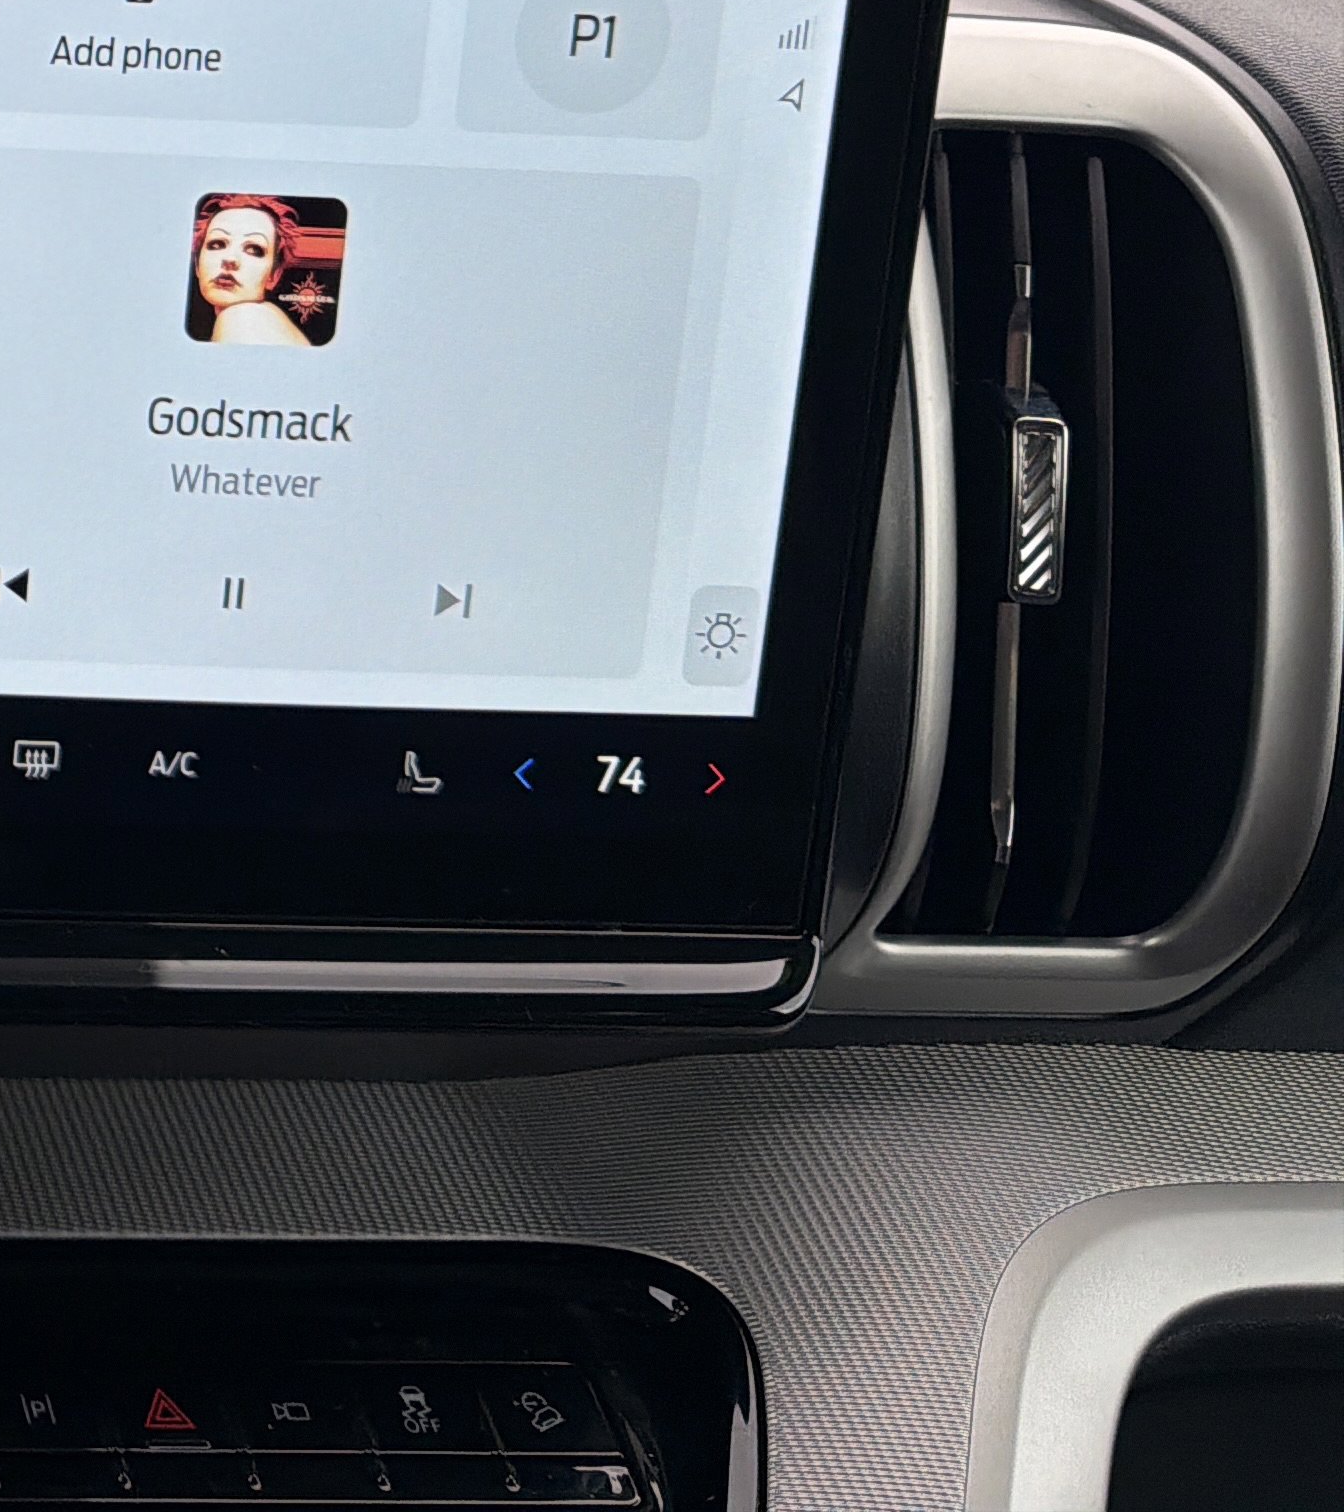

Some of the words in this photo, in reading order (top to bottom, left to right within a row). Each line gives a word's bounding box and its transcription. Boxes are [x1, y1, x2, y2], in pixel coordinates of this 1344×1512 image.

[50, 34, 115, 68] Add
[122, 38, 222, 75] phone
[569, 13, 618, 61] P1
[146, 397, 354, 445] Godsmack
[170, 463, 322, 500] Whatever
[147, 749, 200, 779] A/C
[595, 754, 646, 795] 74
[404, 1417, 441, 1434] OFF
